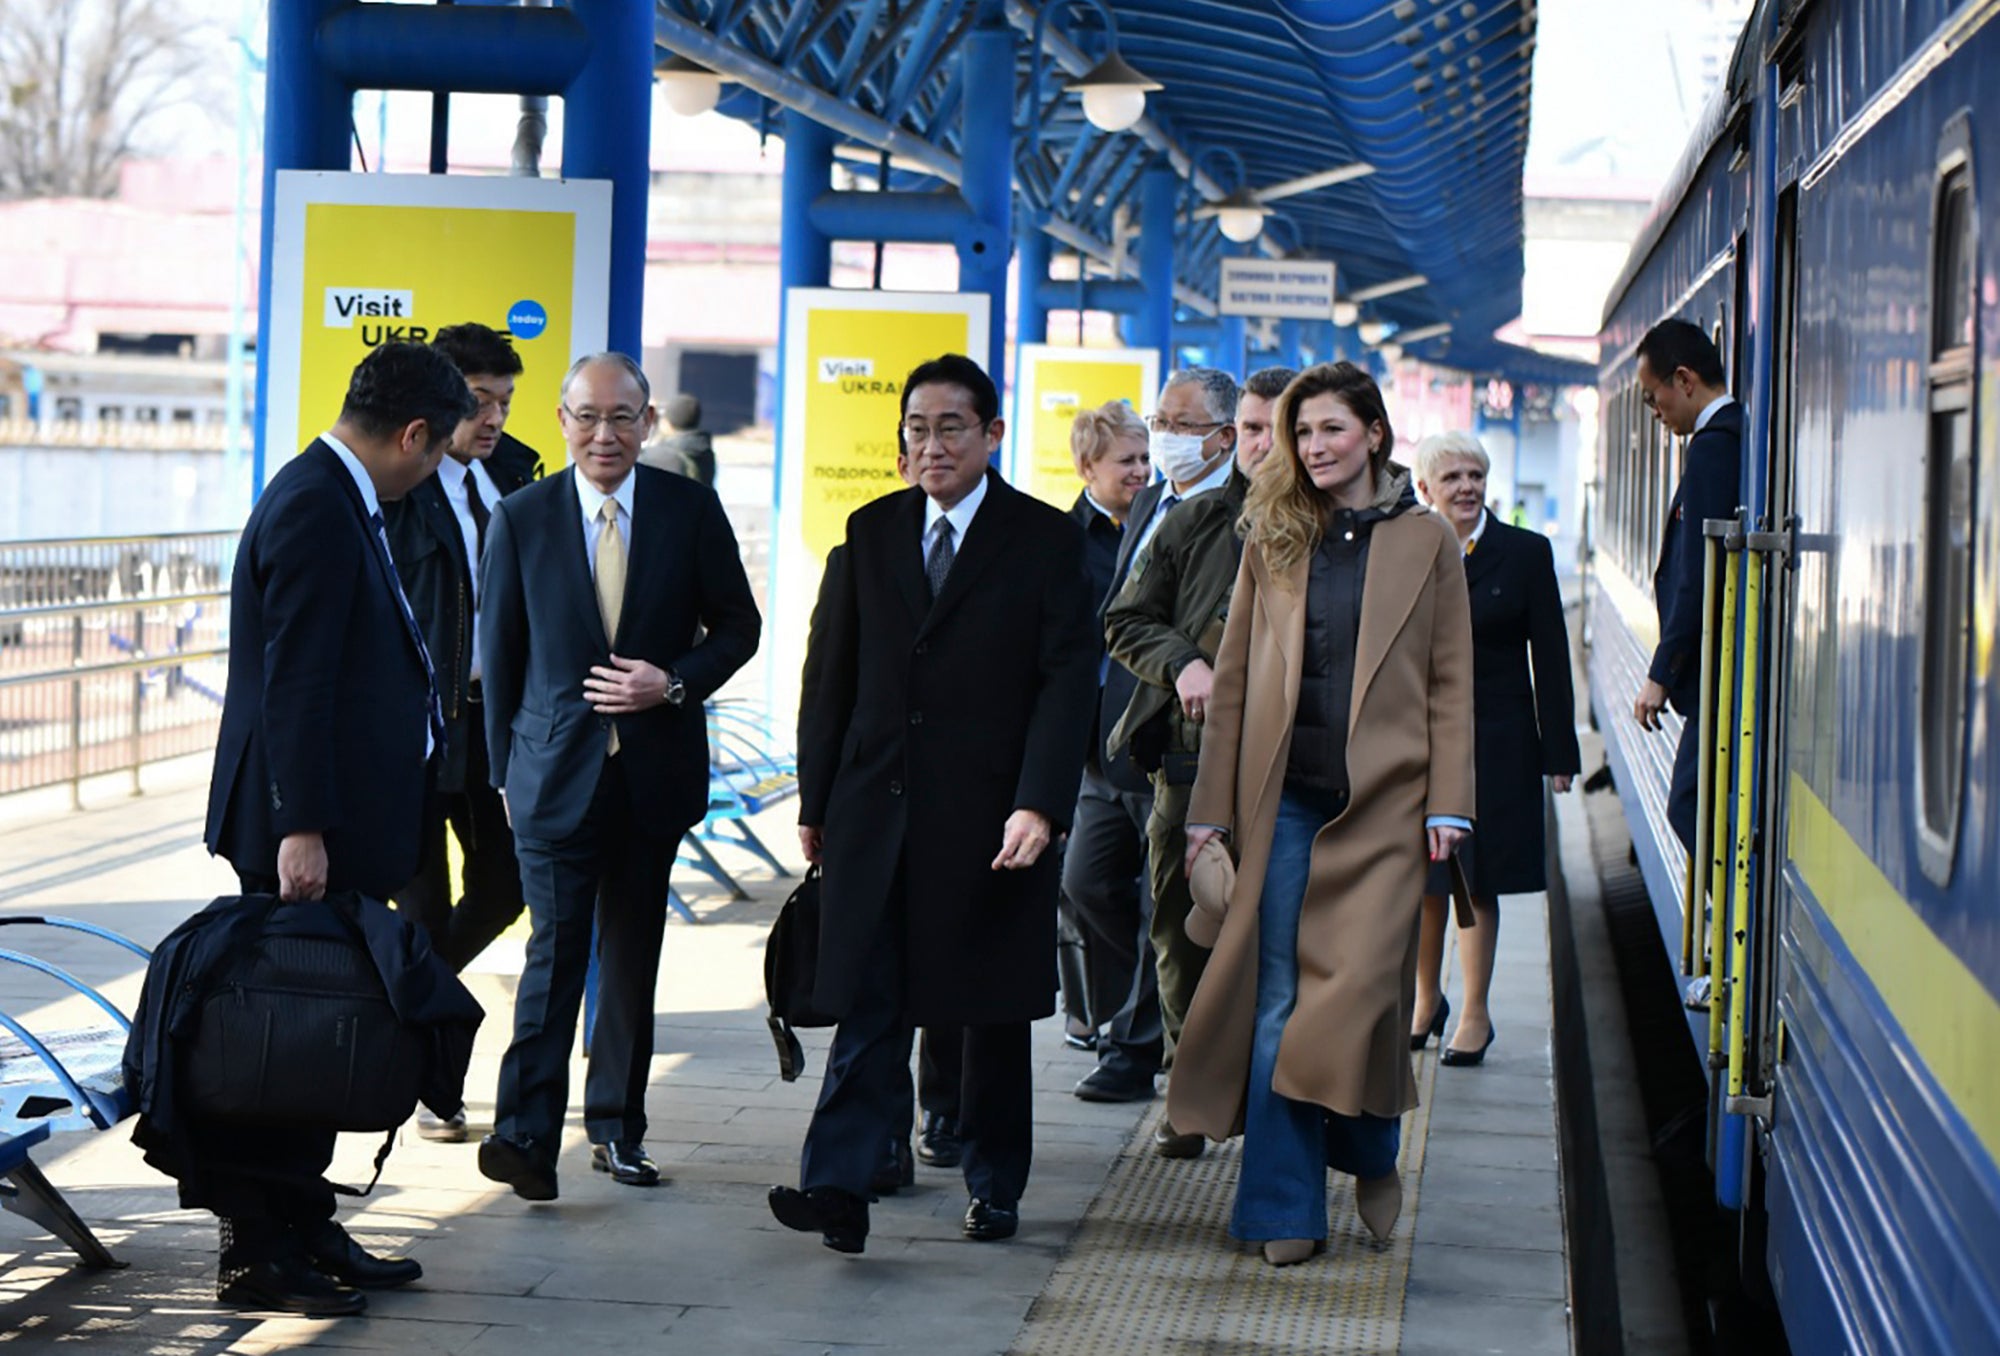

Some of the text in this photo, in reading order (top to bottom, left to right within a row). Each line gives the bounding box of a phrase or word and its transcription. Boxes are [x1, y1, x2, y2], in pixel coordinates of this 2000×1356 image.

[334, 294, 402, 318] Visit
[825, 362, 867, 377] Visit
[841, 381, 904, 395] UKRAI
[855, 441, 897, 458] КУД
[814, 466, 898, 480] ПОДОРОЖ
